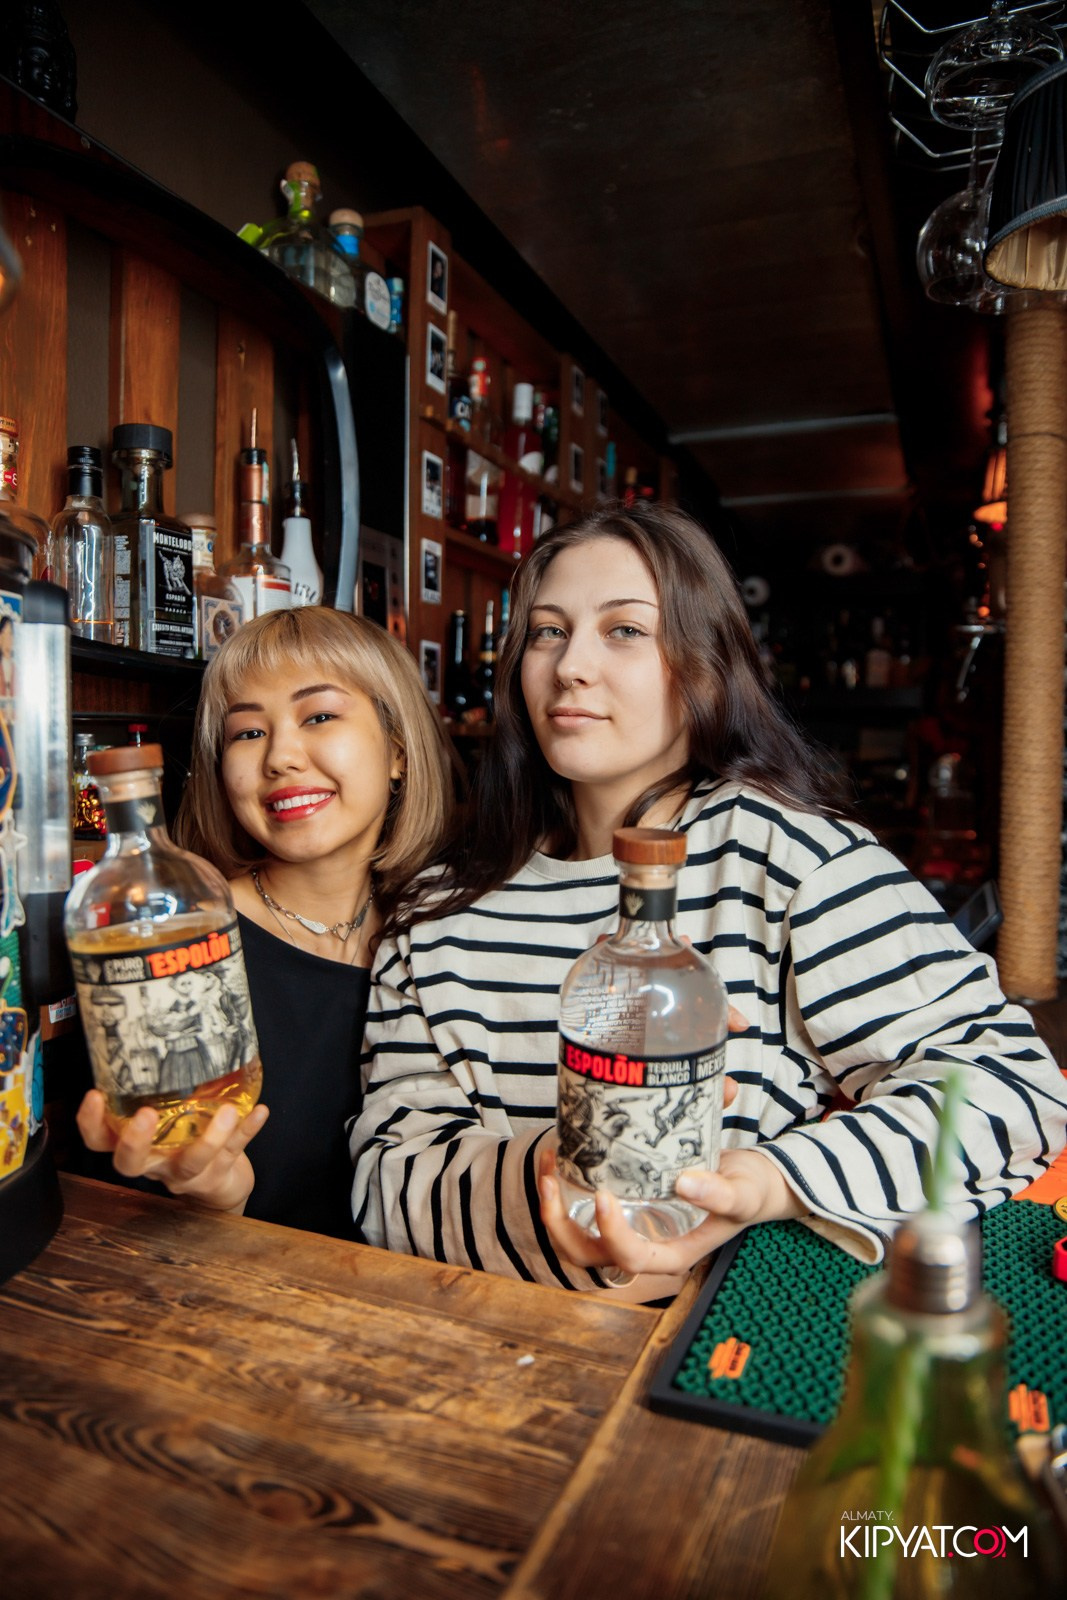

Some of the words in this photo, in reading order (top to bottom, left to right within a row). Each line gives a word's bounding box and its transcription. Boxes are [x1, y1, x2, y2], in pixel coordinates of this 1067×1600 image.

[153, 531, 192, 551] MONTELOBO
[646, 1059, 690, 1073] TEQUILA
[646, 1072, 690, 1086] BLANCO
